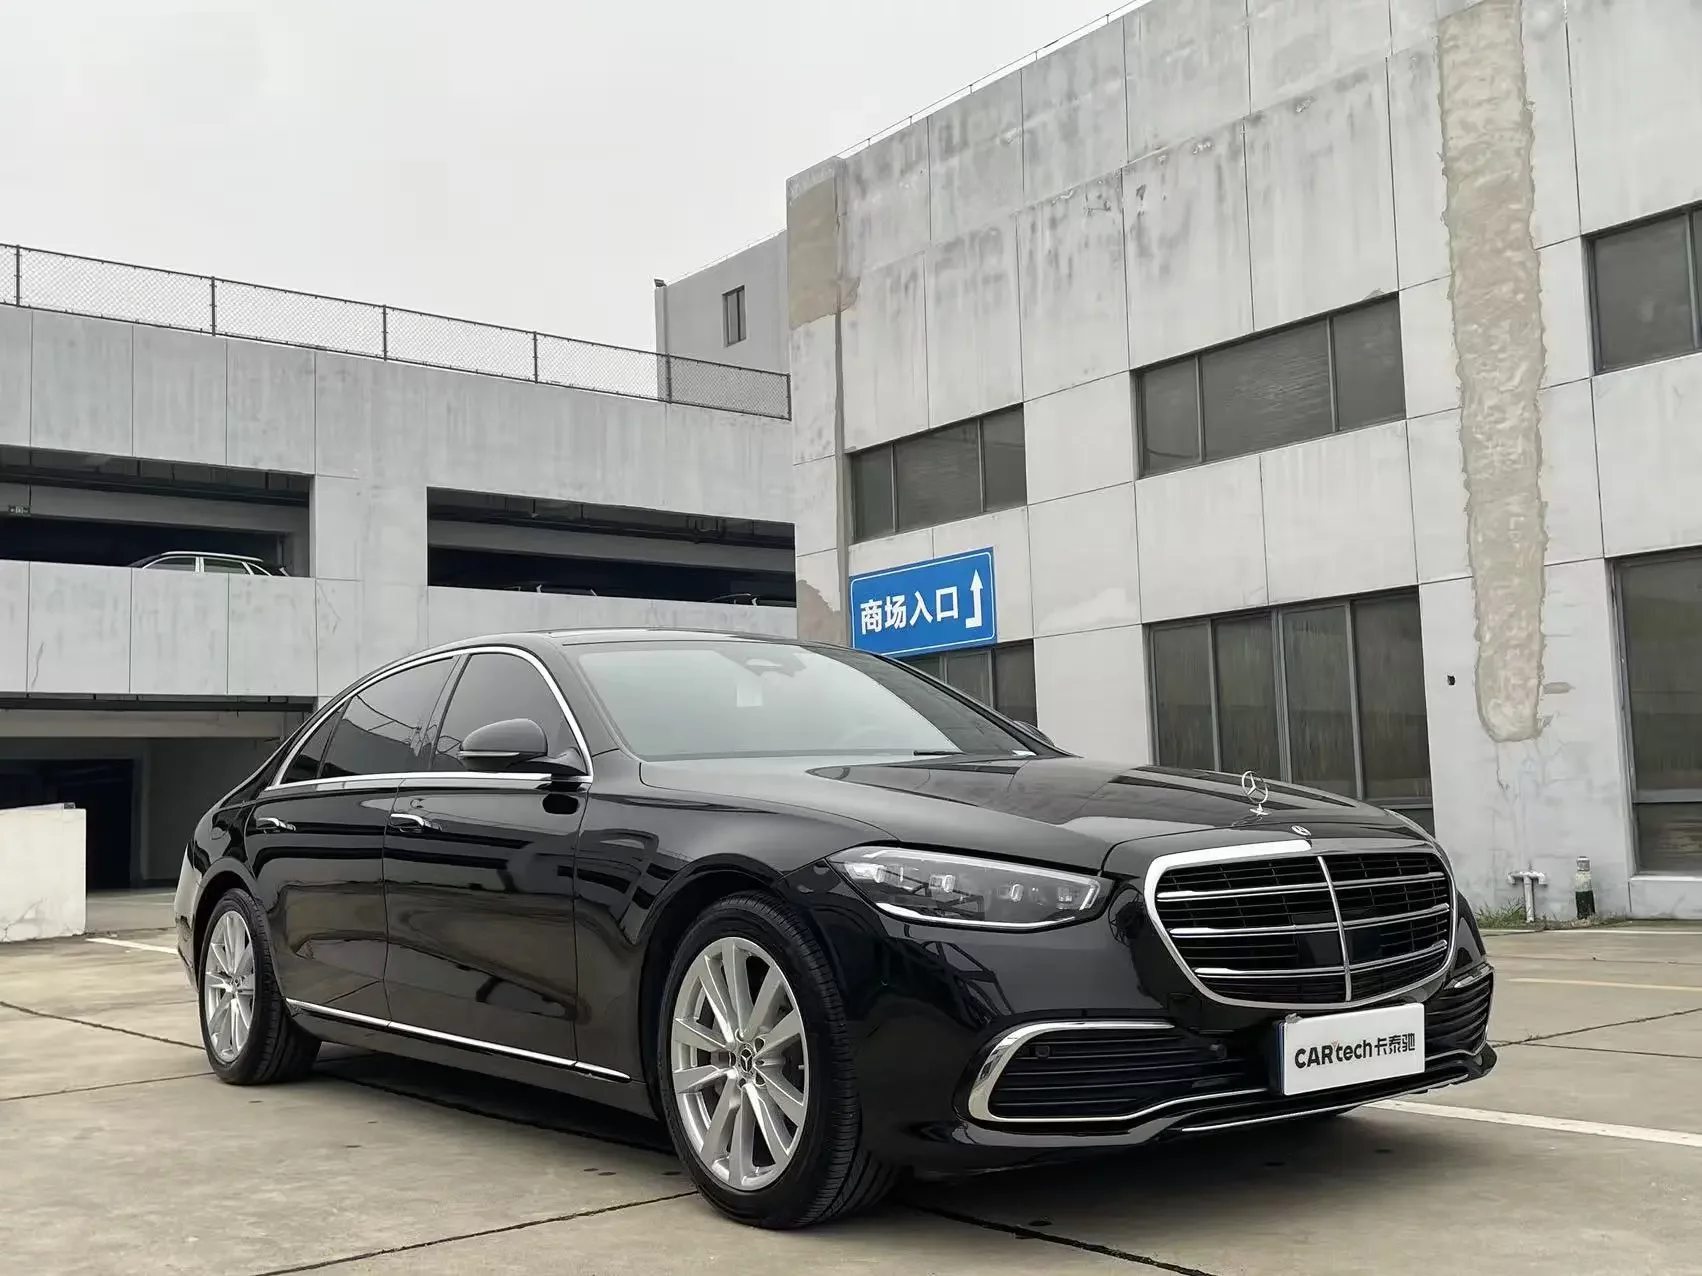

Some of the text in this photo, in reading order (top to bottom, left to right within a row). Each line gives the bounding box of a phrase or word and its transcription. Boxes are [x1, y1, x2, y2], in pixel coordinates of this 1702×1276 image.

[860, 586, 959, 634] 商场入口
[1294, 1032, 1416, 1069] CARtech 卡泰驰
